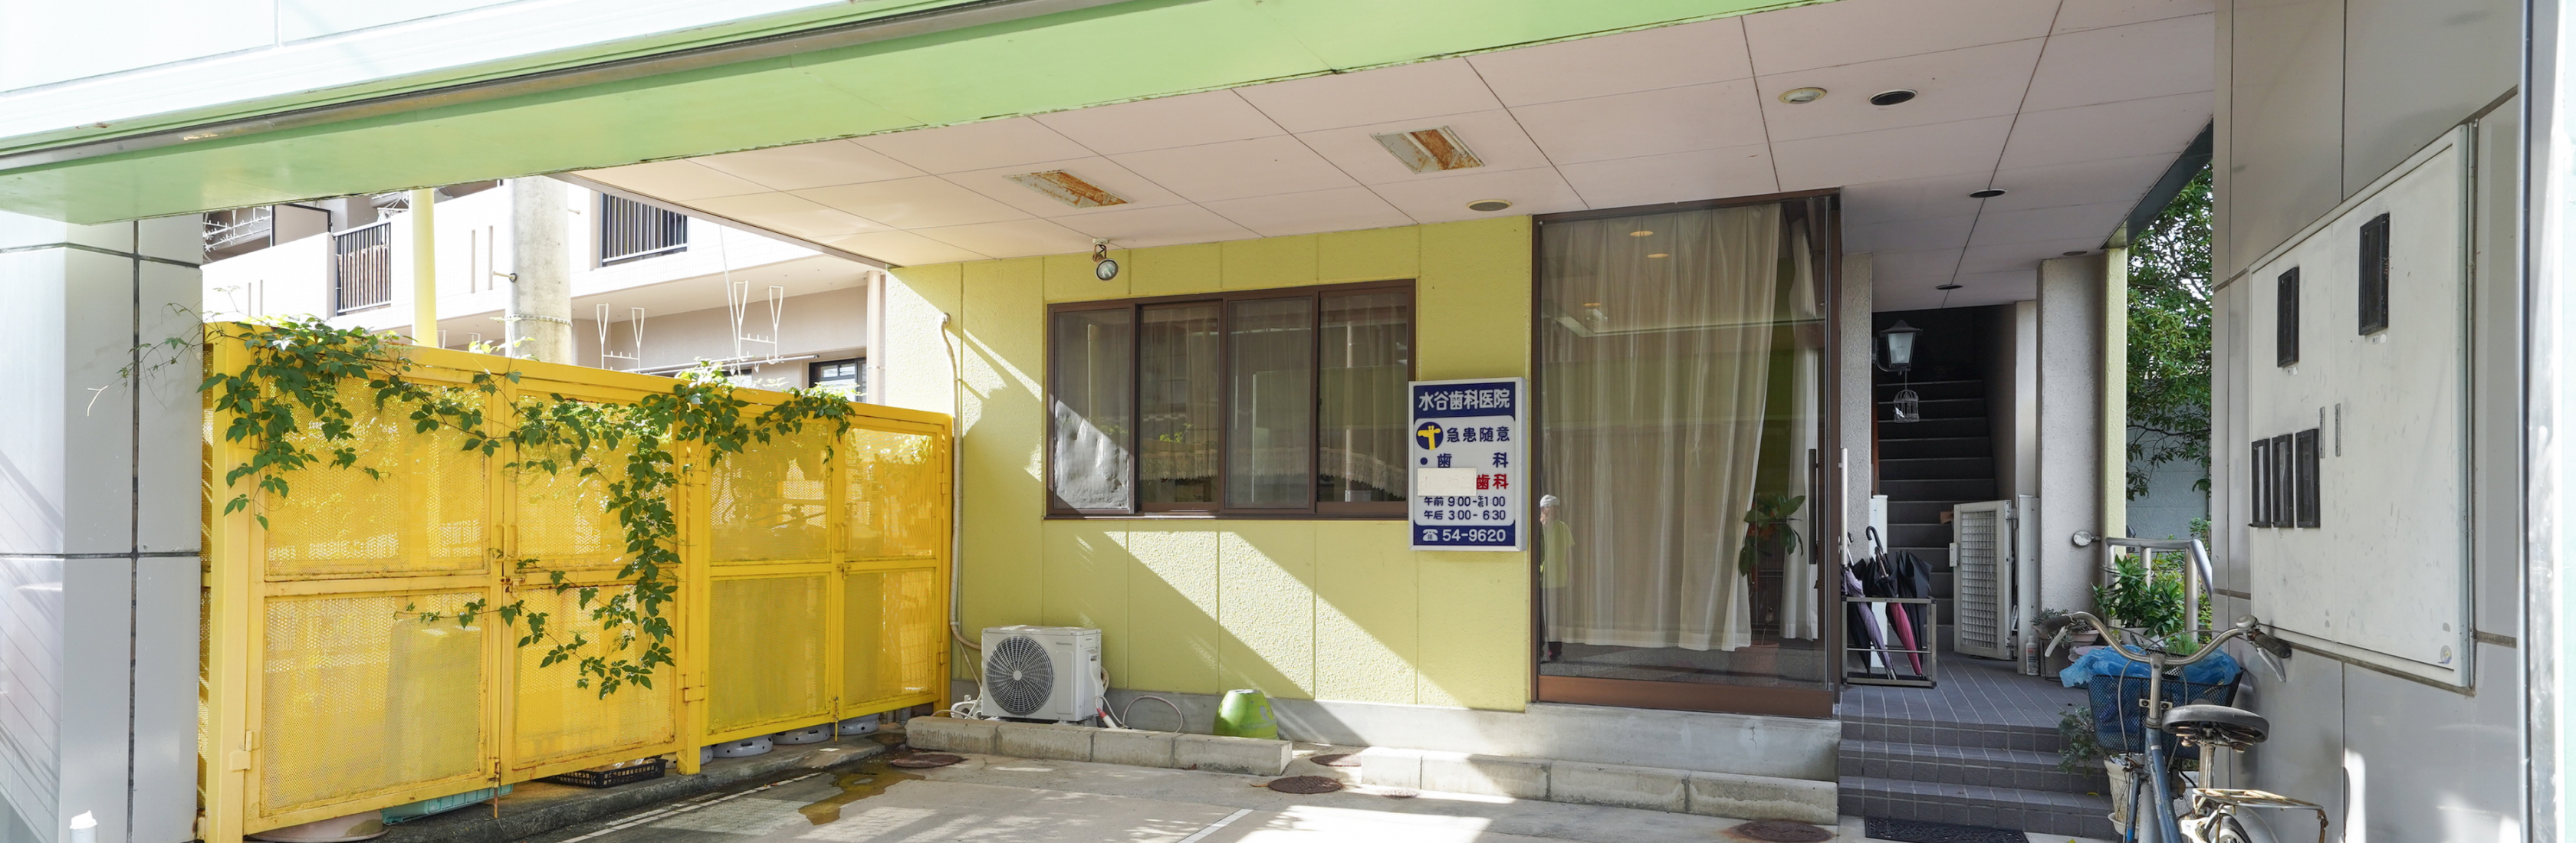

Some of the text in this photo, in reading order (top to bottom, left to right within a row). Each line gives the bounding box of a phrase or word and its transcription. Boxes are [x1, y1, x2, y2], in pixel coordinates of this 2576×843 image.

[1418, 389, 1510, 411] 水谷歯科医院
[1447, 426, 1510, 443] 急患随意
[1442, 529, 1506, 542] 54-9620
